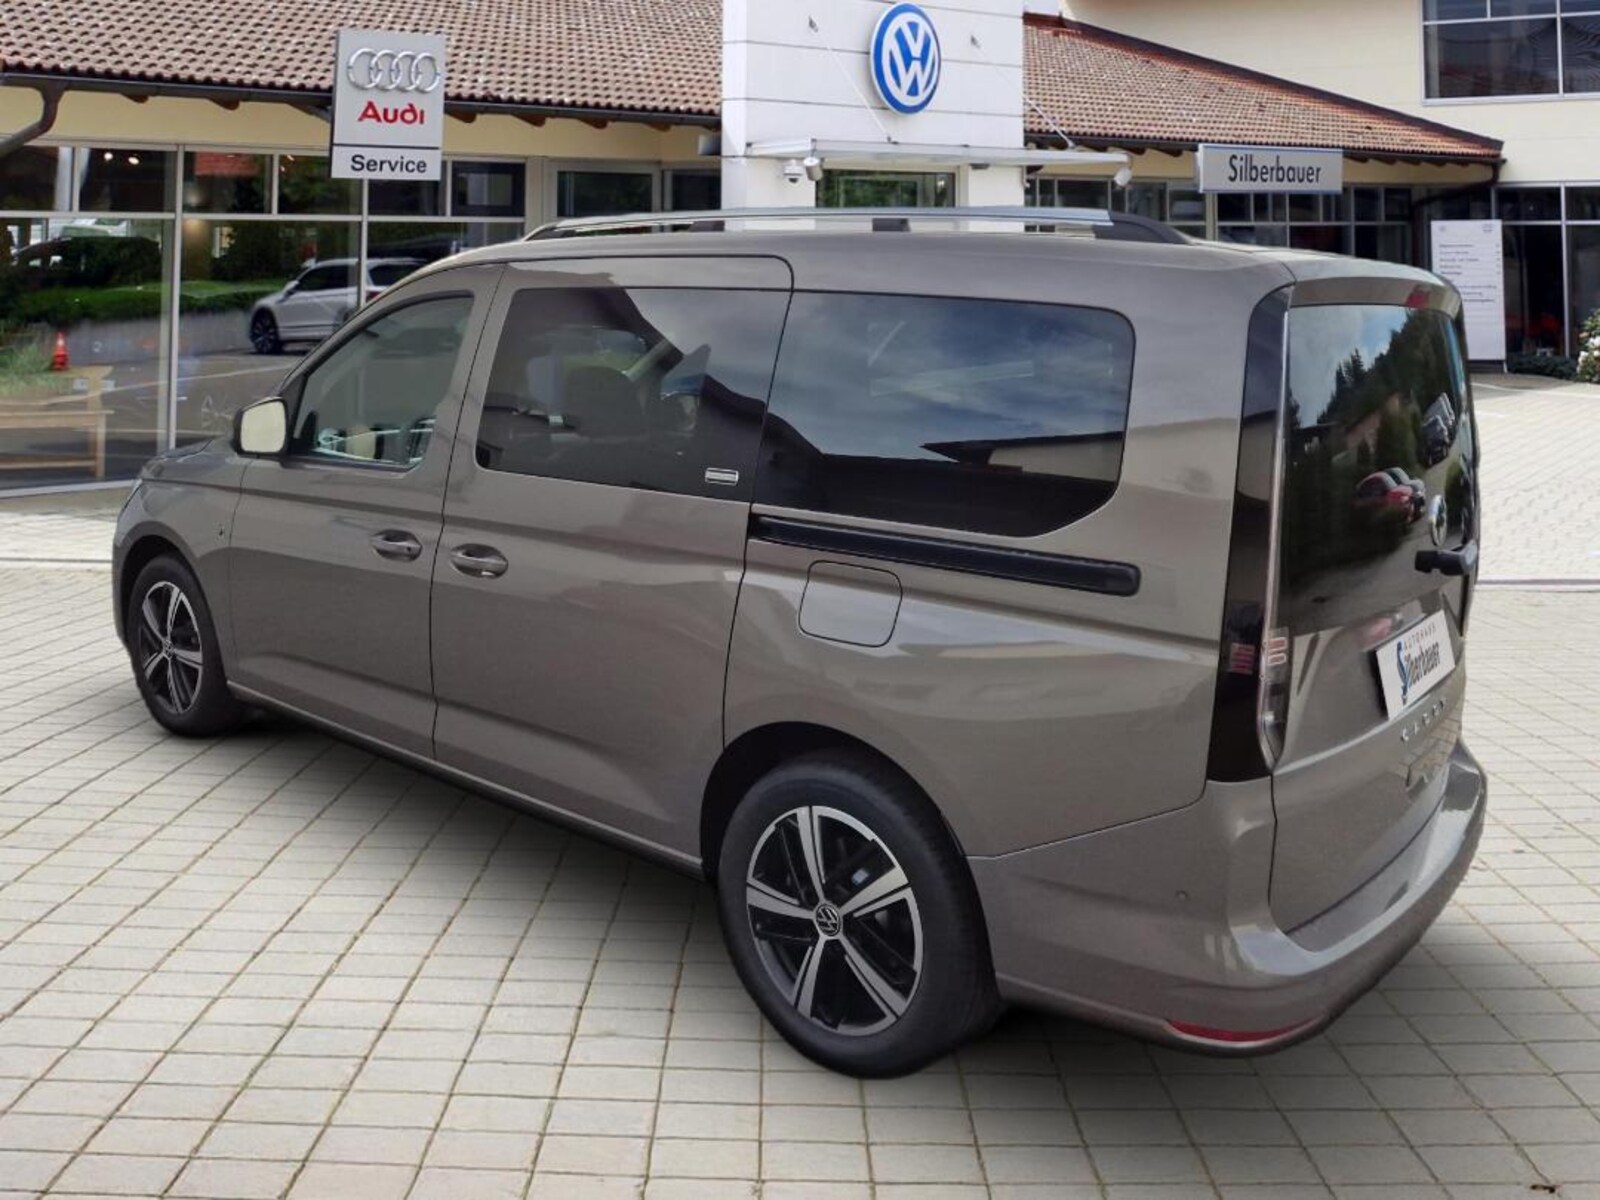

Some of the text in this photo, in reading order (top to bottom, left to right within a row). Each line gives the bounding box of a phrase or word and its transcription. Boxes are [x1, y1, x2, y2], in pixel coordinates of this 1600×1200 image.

[358, 101, 425, 125] Audi
[350, 154, 427, 173] Service
[1228, 154, 1321, 183] Silberbauer
